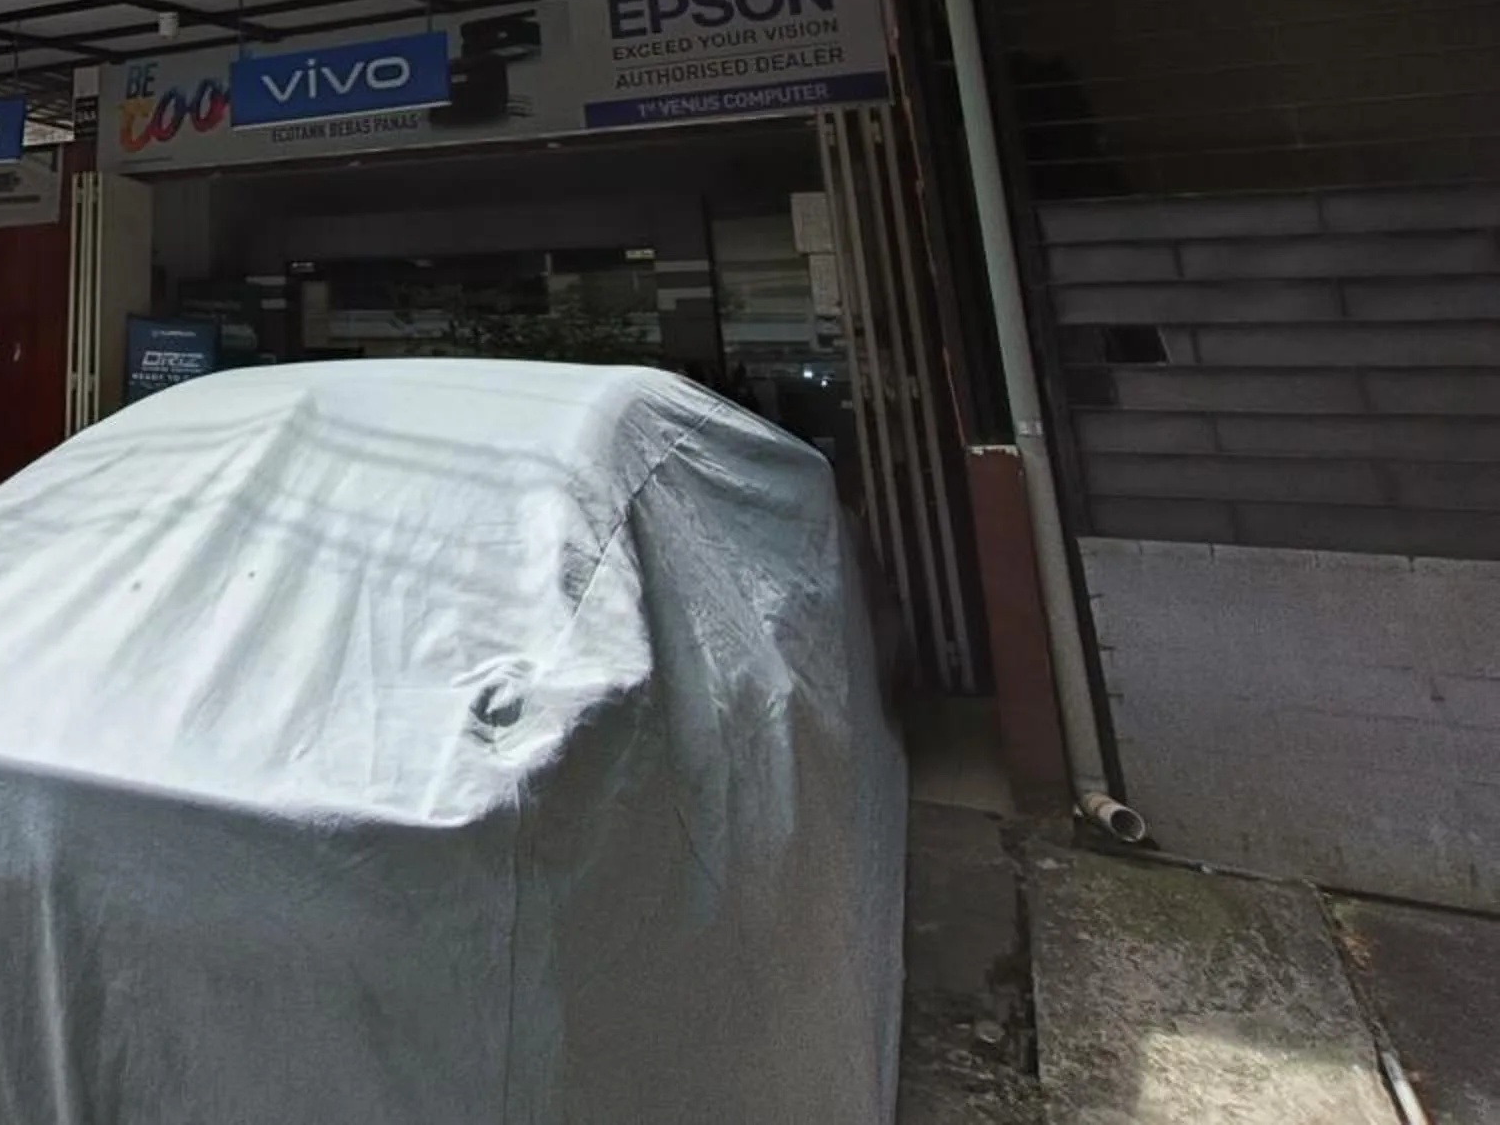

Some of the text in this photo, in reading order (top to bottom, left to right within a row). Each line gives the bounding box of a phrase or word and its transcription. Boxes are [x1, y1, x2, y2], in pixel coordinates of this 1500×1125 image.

[612, 18, 839, 61] EXCEED YOUR VISION
[126, 63, 158, 99] BE
[260, 56, 411, 103] vivo
[615, 46, 845, 89] AUTHORISED DEALER
[660, 96, 721, 116] VENUS
[724, 83, 831, 108] COMPUTER
